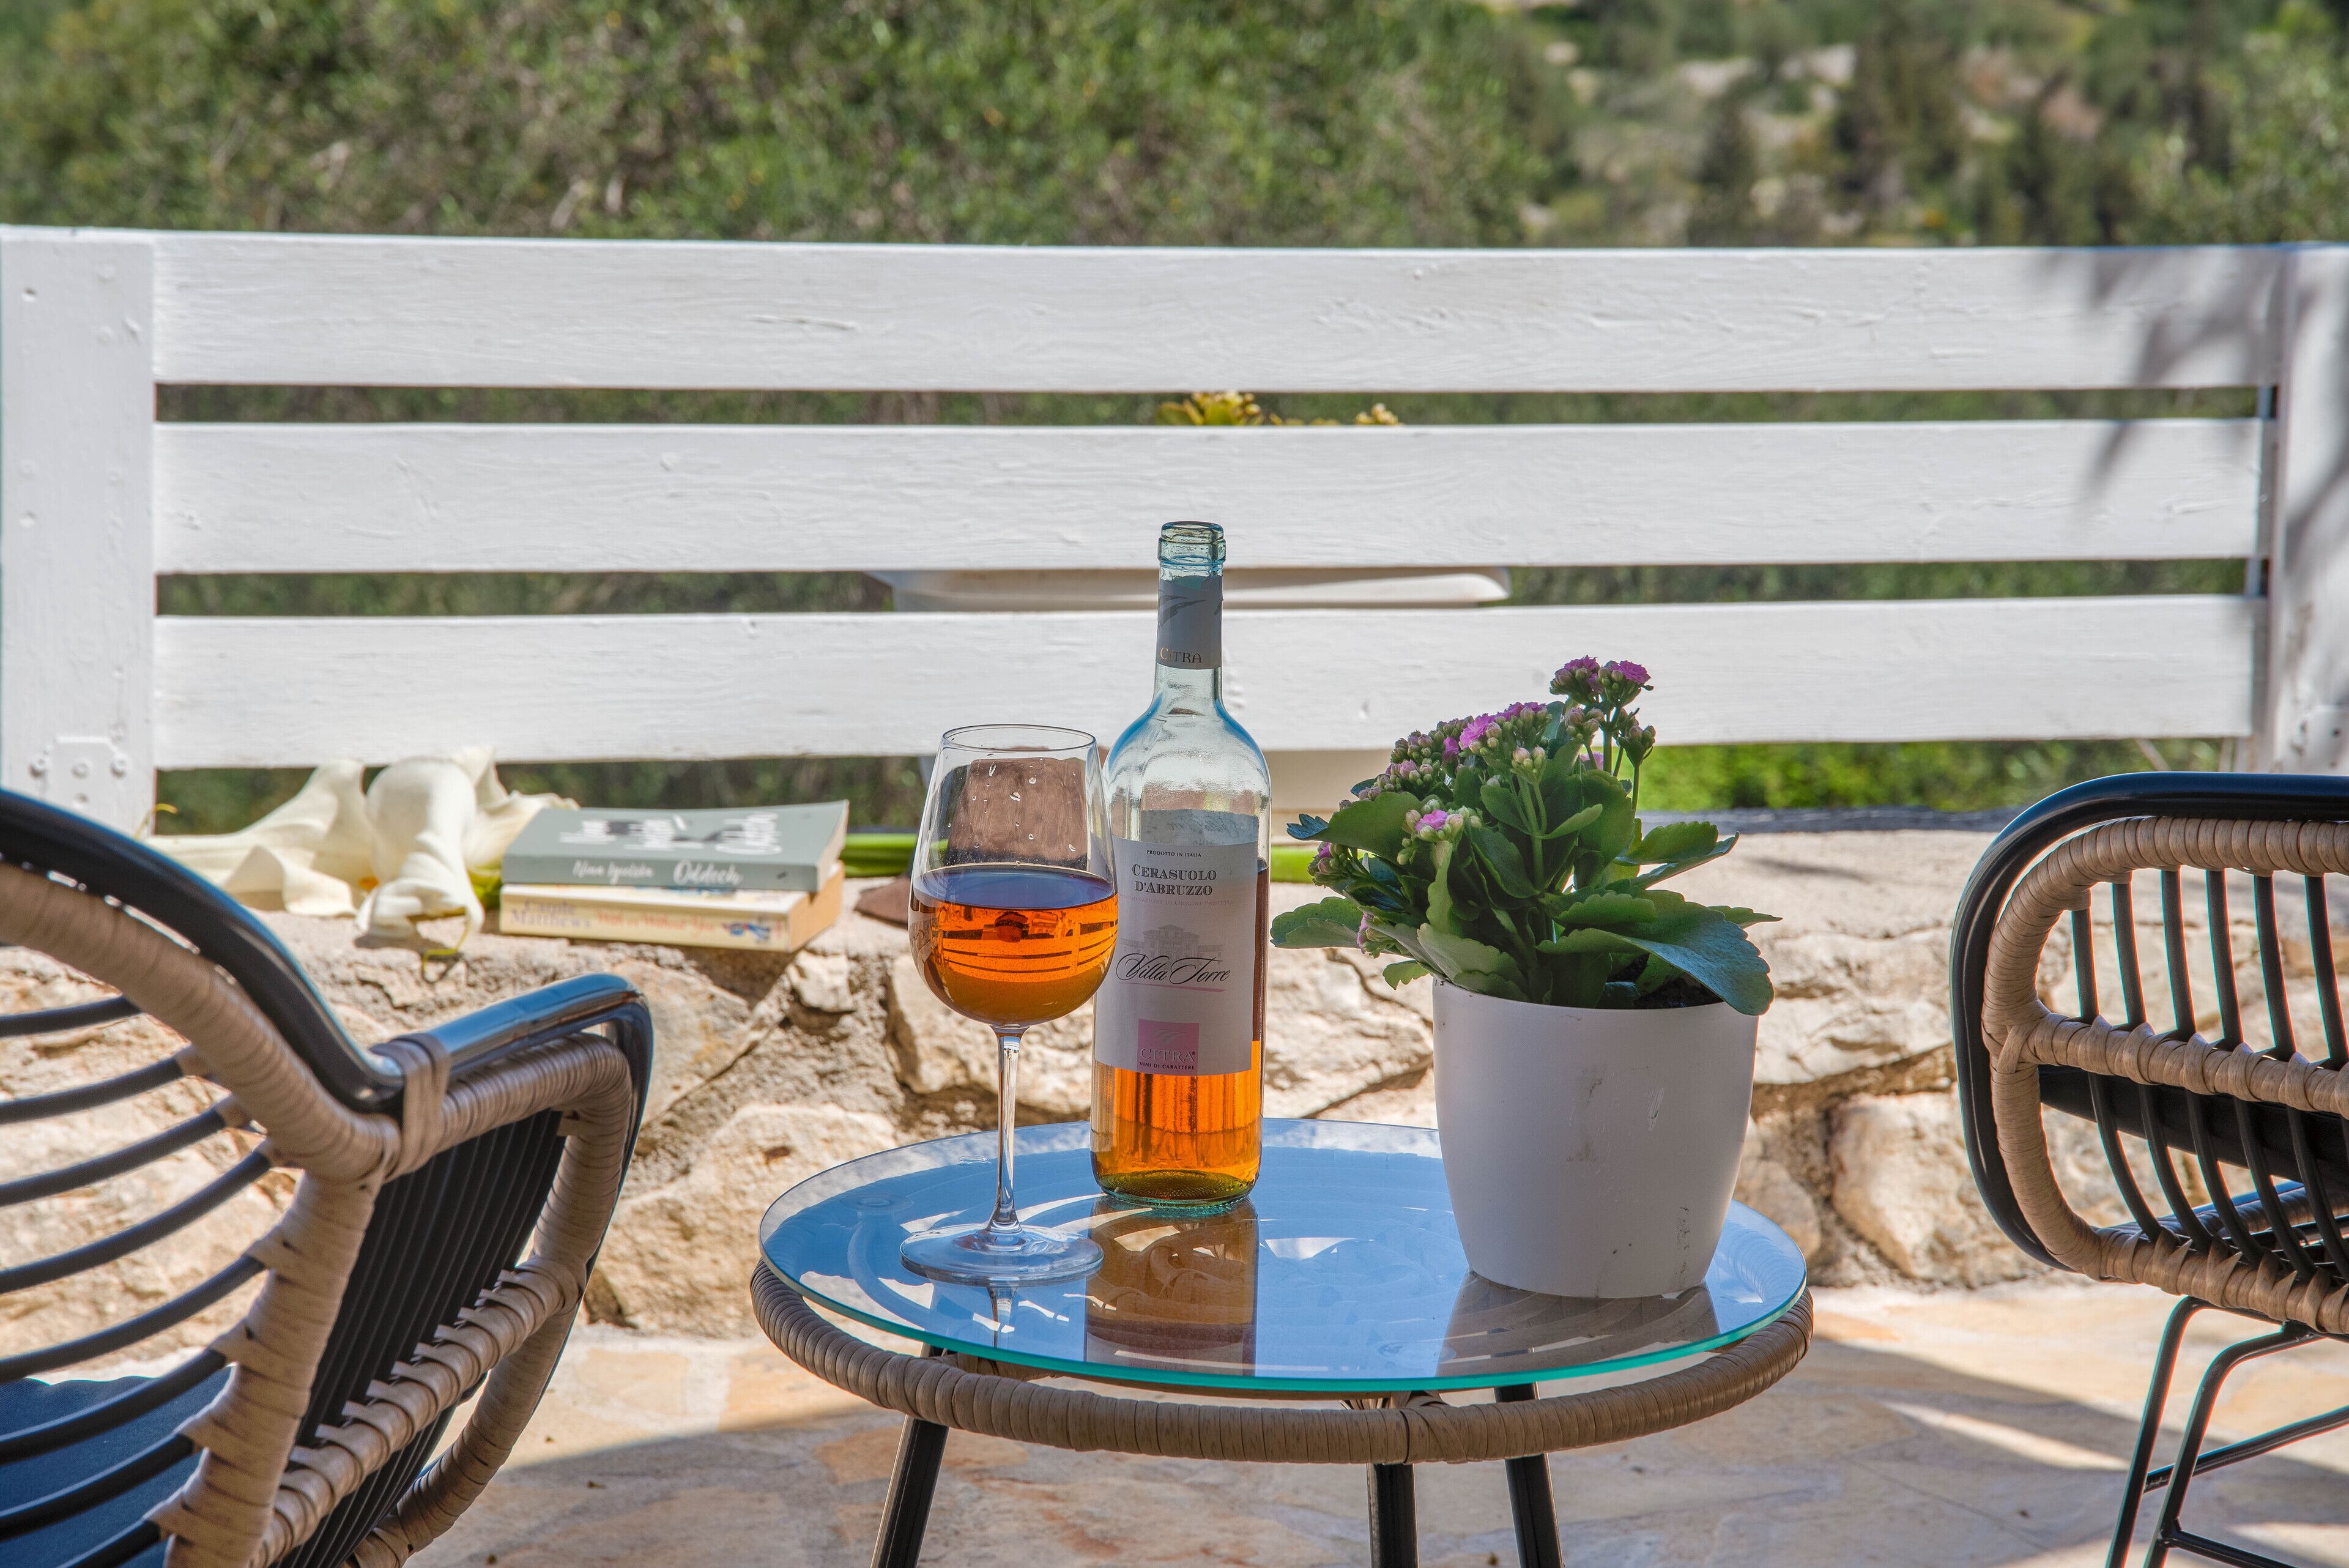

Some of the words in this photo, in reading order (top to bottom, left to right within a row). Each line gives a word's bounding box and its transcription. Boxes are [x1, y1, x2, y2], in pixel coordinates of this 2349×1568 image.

[1160, 647, 1203, 663] CITRA
[674, 858, 744, 885] Oddech
[1132, 864, 1217, 880] CERASUOLO
[1135, 881, 1212, 896] D'ABRUZZO
[1116, 953, 1170, 981] Villa
[1169, 957, 1231, 984] Torre
